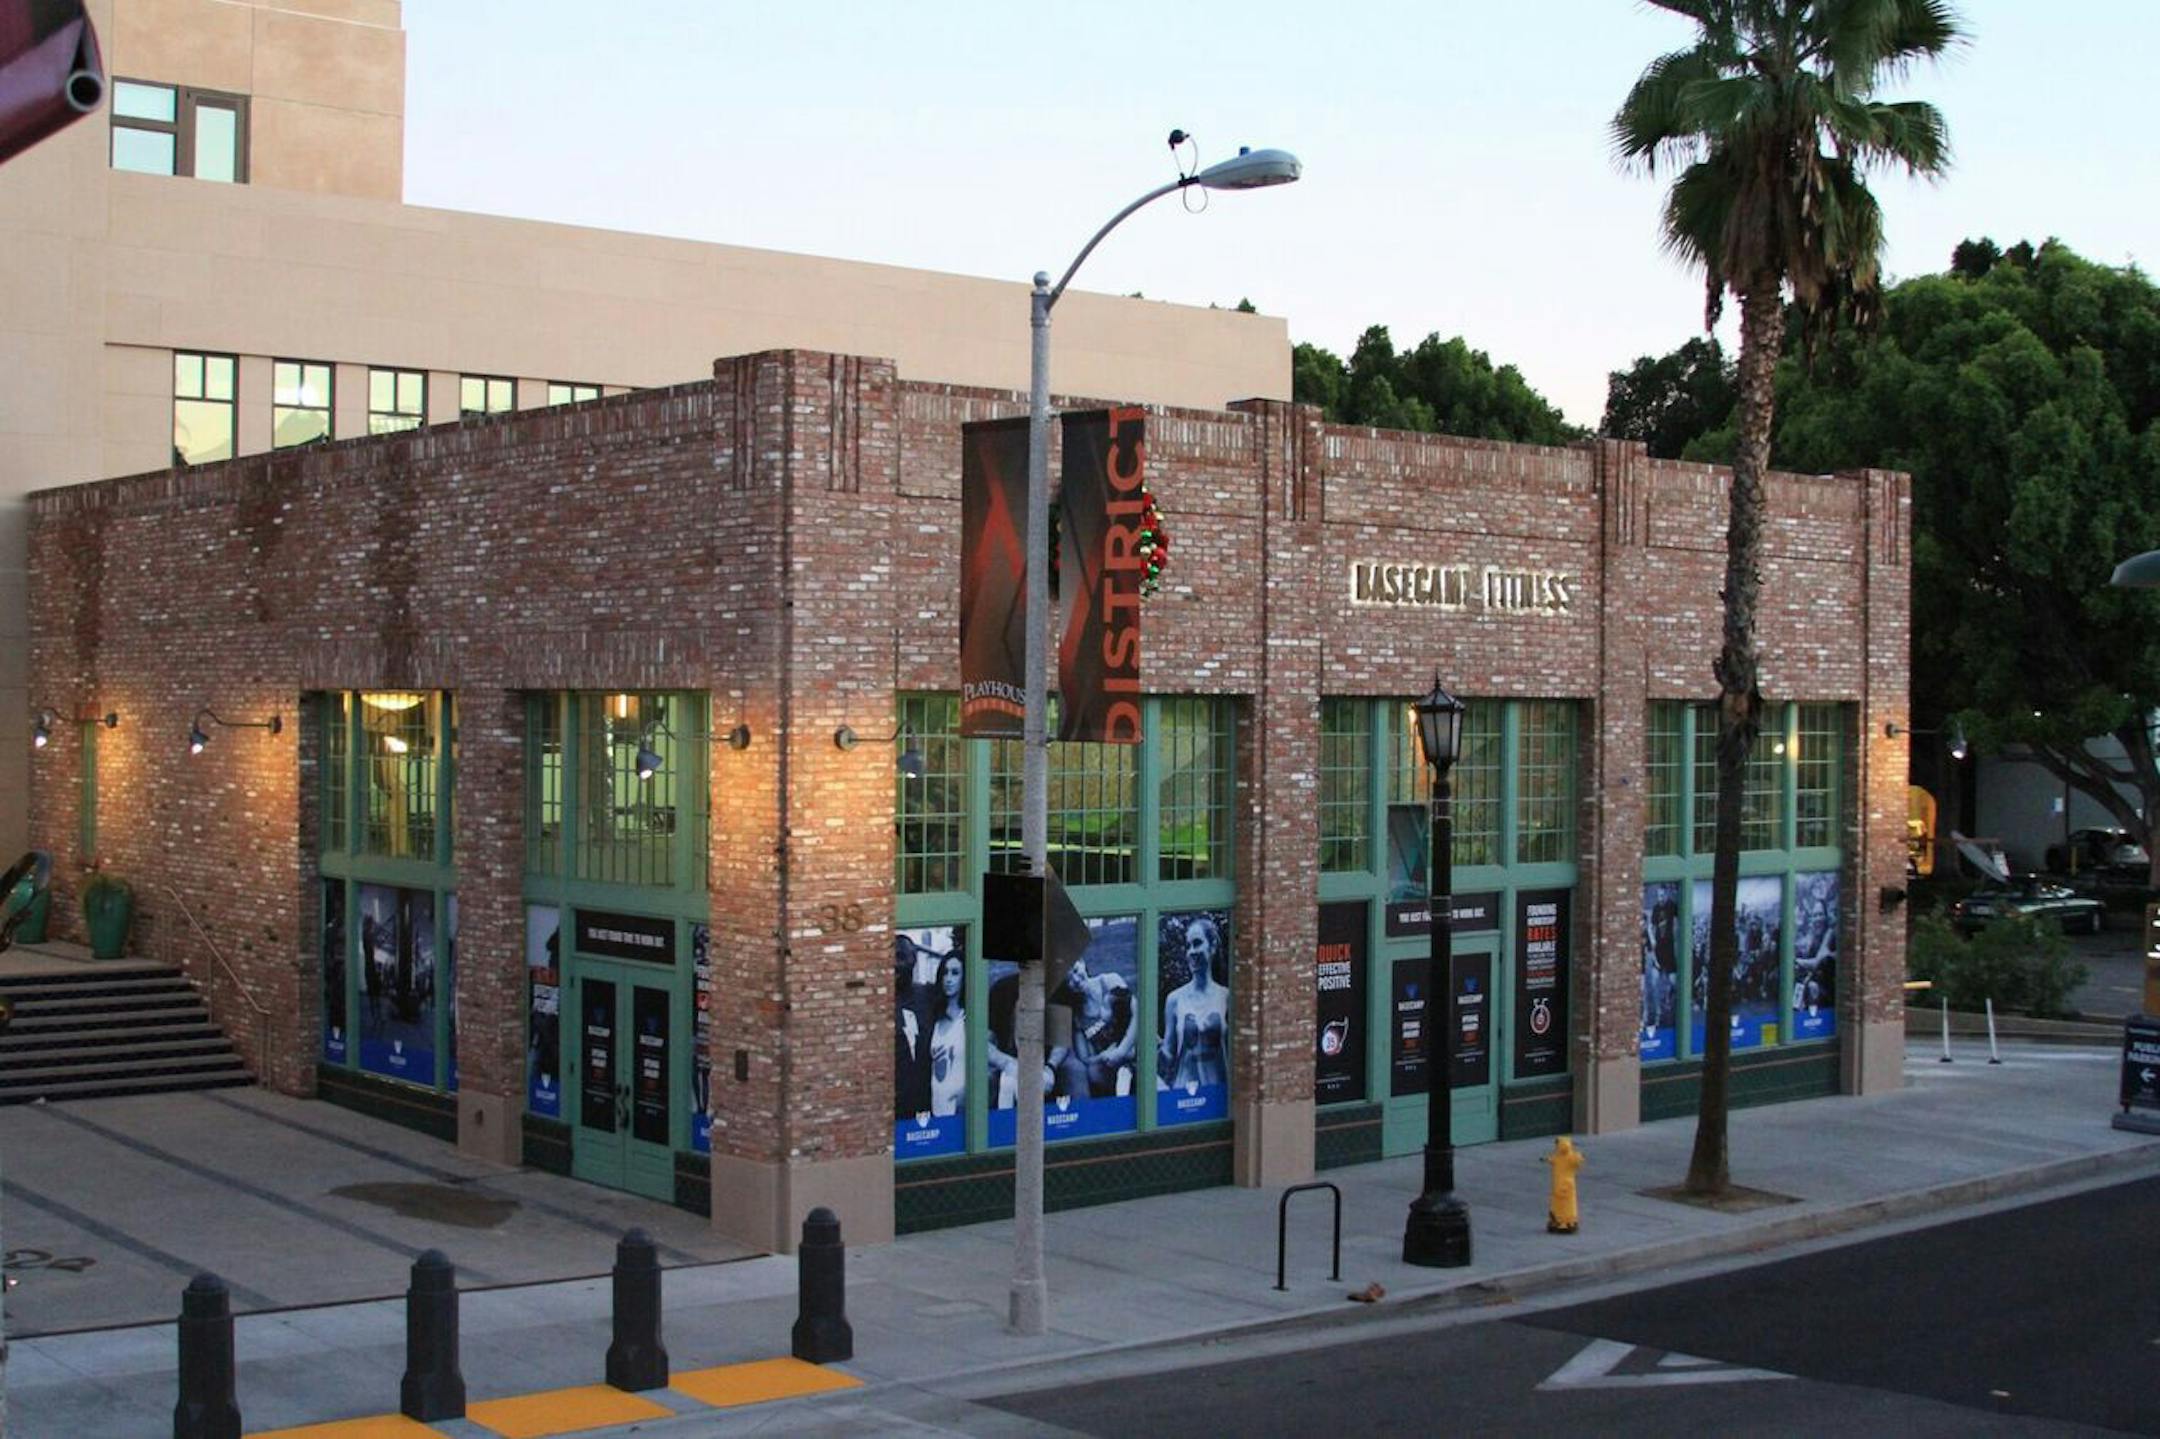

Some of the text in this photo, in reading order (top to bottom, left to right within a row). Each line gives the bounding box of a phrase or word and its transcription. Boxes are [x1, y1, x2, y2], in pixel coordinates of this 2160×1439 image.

[1103, 404, 1146, 744] DISTRICT
[1352, 563, 1577, 613] BASECAMP FITNESS
[964, 680, 1026, 704] PLAYHOUS
[820, 904, 865, 933] 38
[1318, 944, 1352, 962] QUICK
[1318, 974, 1352, 991] POSITIVE
